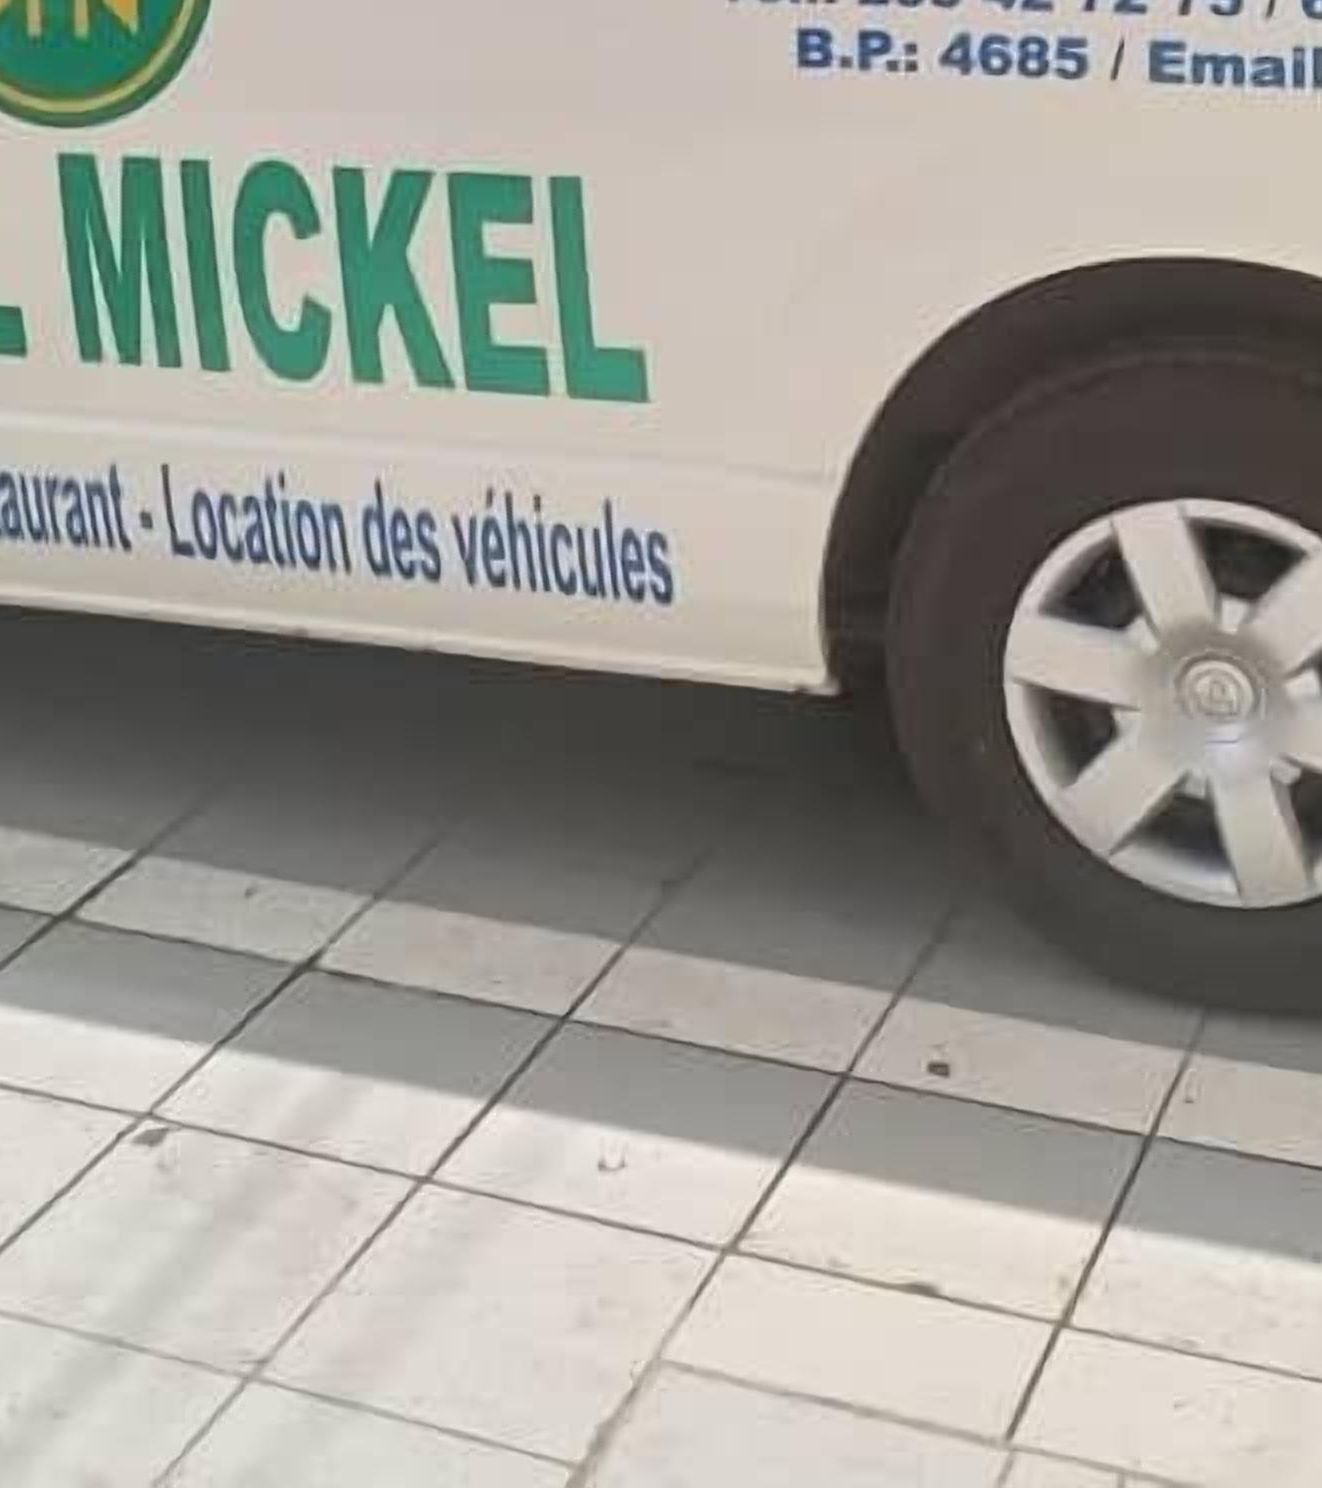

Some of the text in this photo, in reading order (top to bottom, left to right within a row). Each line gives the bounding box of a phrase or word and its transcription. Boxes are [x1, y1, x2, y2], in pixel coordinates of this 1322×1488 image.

[796, 27, 919, 73] B.P.:
[938, 31, 1090, 81] 4685
[1110, 38, 1125, 82] /
[57, 152, 651, 404] MICKEL
[161, 463, 352, 575] Location
[362, 480, 442, 584] des
[451, 488, 674, 606] véhicules
